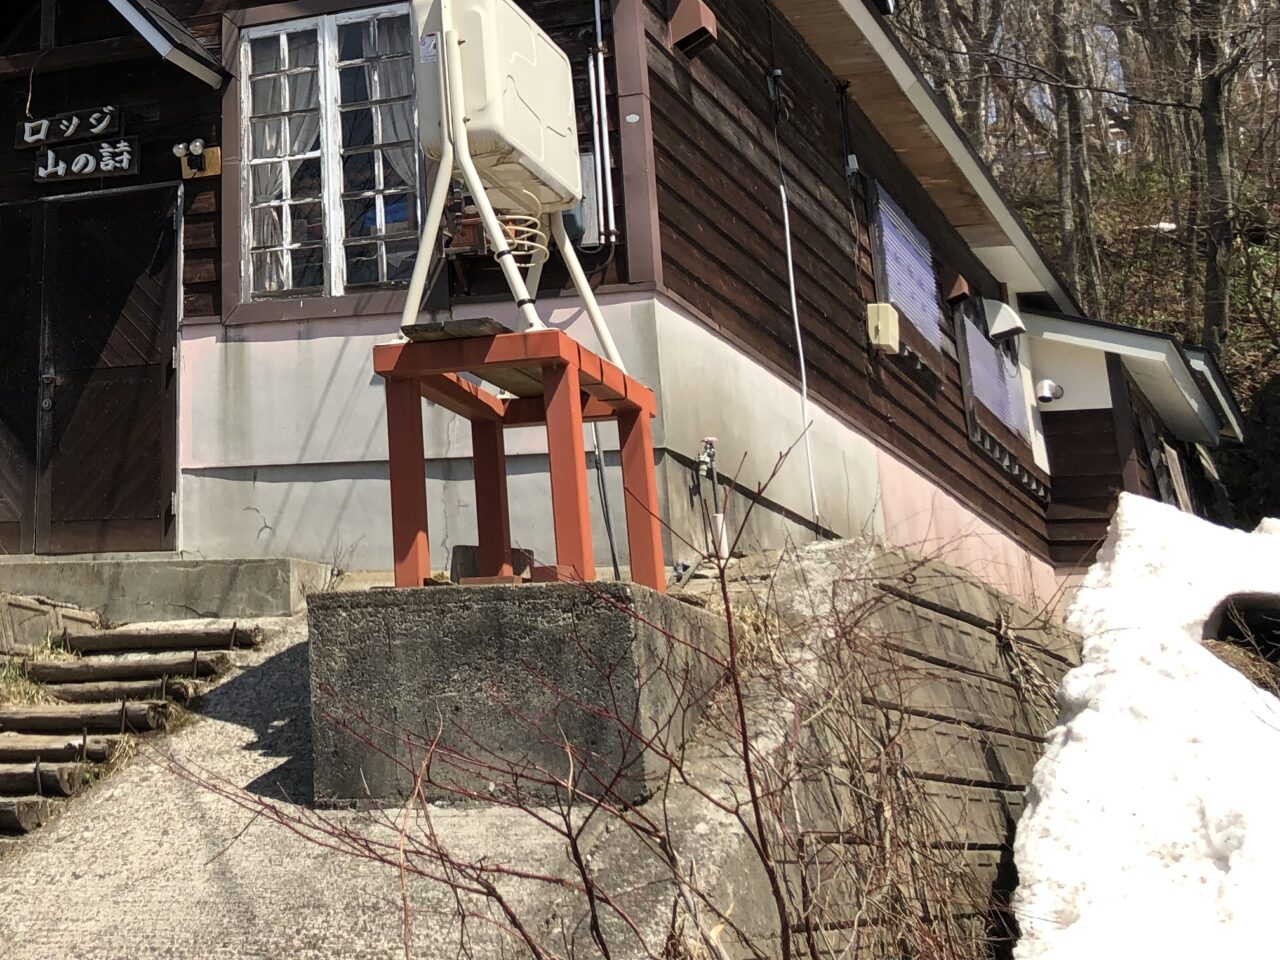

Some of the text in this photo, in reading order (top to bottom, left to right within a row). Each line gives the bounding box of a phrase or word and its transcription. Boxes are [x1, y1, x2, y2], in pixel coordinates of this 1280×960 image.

[24, 105, 114, 143] ロッジ
[39, 140, 132, 178] 山の詩
